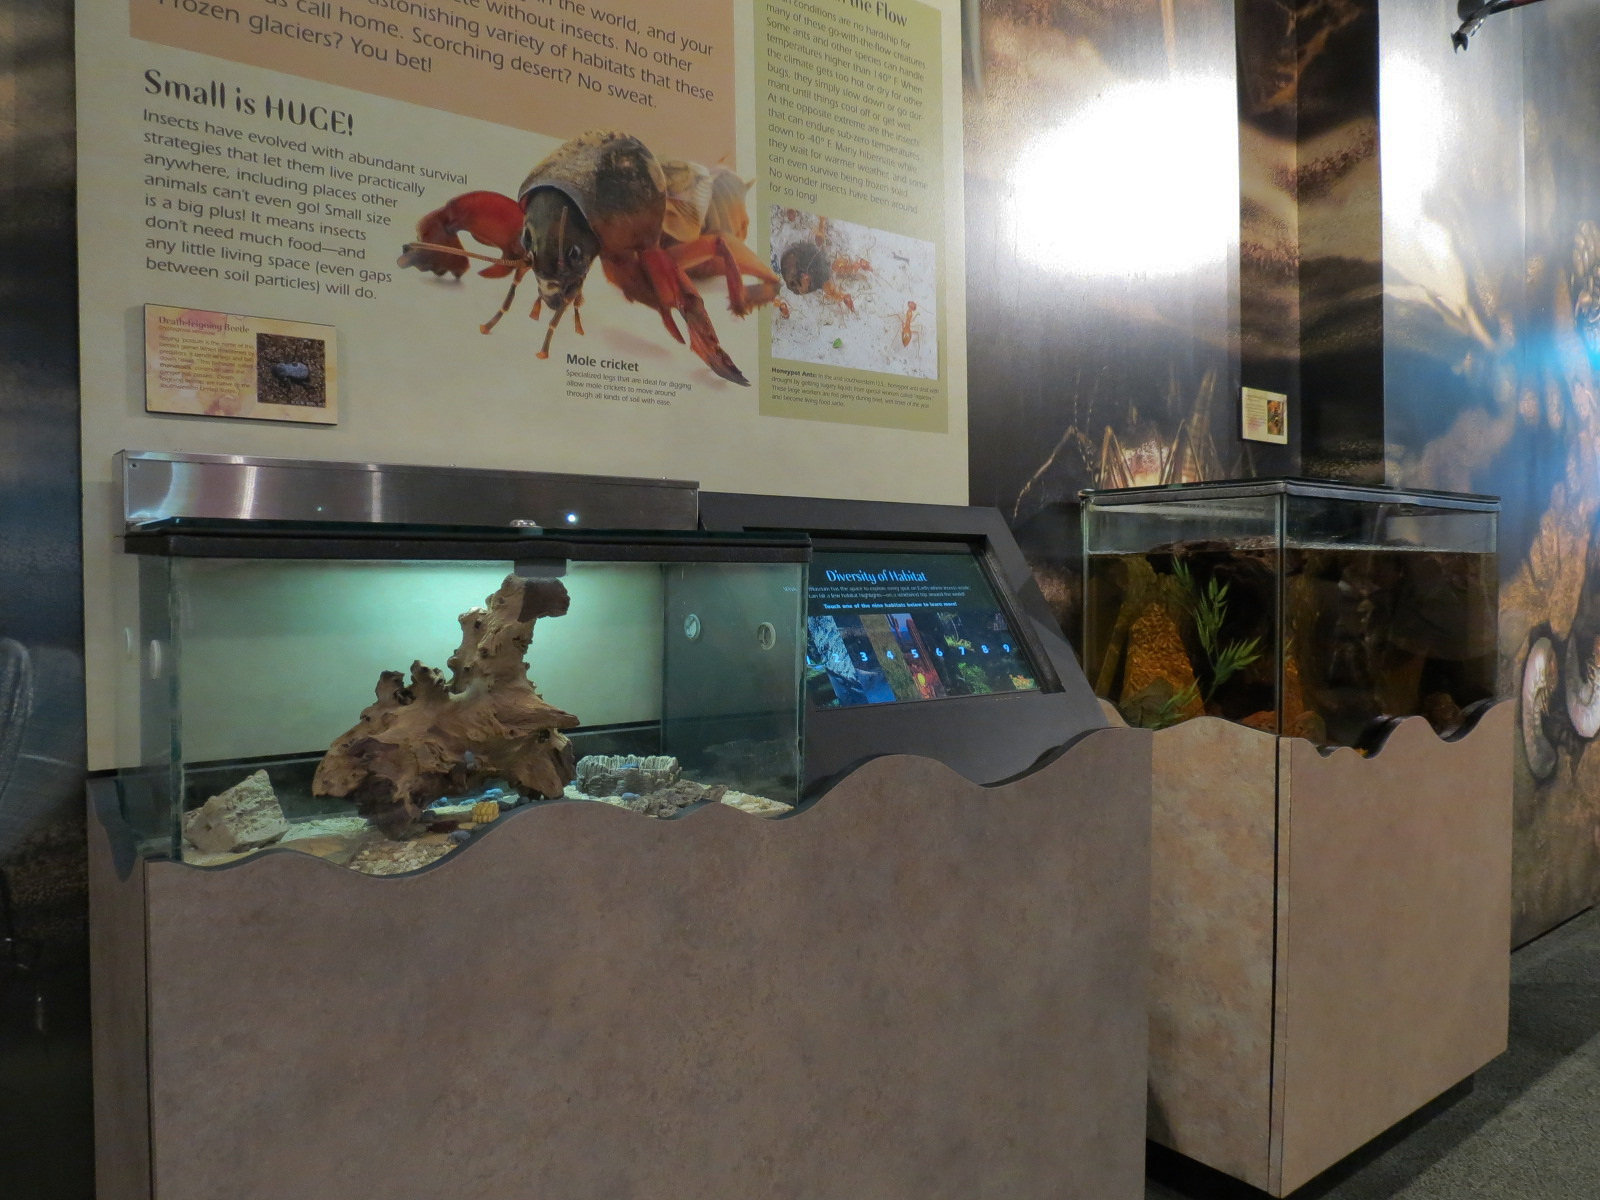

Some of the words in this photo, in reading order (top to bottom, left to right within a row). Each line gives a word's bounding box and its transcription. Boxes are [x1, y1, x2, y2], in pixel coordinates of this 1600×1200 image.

[159, 0, 240, 23] rozen
[249, 14, 344, 49] glaciers?
[350, 35, 389, 62] You
[396, 48, 433, 73] bet!
[486, 0, 556, 31] without
[561, 20, 619, 50] insects.
[625, 38, 649, 59] No
[653, 51, 693, 73] other
[590, 8, 640, 36] world,
[646, 25, 676, 45] and
[680, 35, 713, 57] your
[876, 0, 908, 28] Flow
[296, 0, 331, 19] call
[340, 6, 404, 39] home.
[411, 26, 504, 70] Scorching
[511, 54, 572, 85] desert?
[578, 72, 603, 93] No
[608, 85, 657, 108] sweat.
[486, 25, 545, 56] variety
[550, 43, 568, 58] of
[572, 46, 636, 79] habitats
[641, 69, 671, 90] that
[675, 79, 714, 102] these
[144, 69, 226, 110] Small
[236, 85, 256, 116] is
[265, 95, 354, 137] HUGE!
[143, 107, 199, 132] Insects
[205, 121, 243, 140] have
[248, 132, 307, 153] evolved
[311, 144, 344, 161] with
[348, 152, 416, 175] abundant
[419, 166, 468, 186] survival
[143, 132, 222, 156] strategies
[227, 147, 258, 164] that
[263, 152, 282, 168] let
[287, 158, 325, 176] them
[330, 165, 354, 181] live
[357, 172, 426, 198] practically
[143, 153, 230, 180] anywhere,
[237, 168, 308, 196] including
[313, 184, 357, 202] places
[361, 192, 399, 209] other
[143, 174, 207, 196] animals
[213, 185, 250, 203] can't
[255, 193, 292, 209] even
[297, 200, 320, 216] go!
[325, 203, 362, 222] Small
[366, 211, 392, 227] size
[145, 193, 156, 207] is
[162, 199, 172, 210] a
[177, 198, 204, 218] big
[209, 206, 246, 223] plus!
[251, 211, 261, 224] It
[265, 216, 315, 233] means
[319, 222, 367, 242] insects
[145, 215, 188, 233] don't
[193, 222, 234, 241] need
[240, 231, 283, 249] much
[288, 236, 366, 261] food—and
[145, 238, 176, 255] any
[181, 240, 215, 257] little
[221, 246, 262, 267] living
[268, 255, 310, 271] space
[315, 261, 355, 280] (even
[359, 268, 392, 285] gaps
[145, 257, 219, 279] between
[224, 267, 249, 283] soil
[255, 273, 320, 295] particles)
[325, 283, 350, 297] will
[355, 285, 377, 299] do.
[566, 353, 597, 367] Mole
[600, 358, 639, 372] cricket
[825, 569, 877, 585] Diversity
[877, 569, 888, 582] of
[888, 570, 928, 582] Habitat
[860, 652, 868, 661] 3
[886, 650, 894, 660] 4
[911, 649, 919, 658] 5
[936, 647, 943, 657] 6
[957, 646, 966, 656] 7
[981, 645, 990, 654] 8
[1003, 644, 1010, 653] 9
